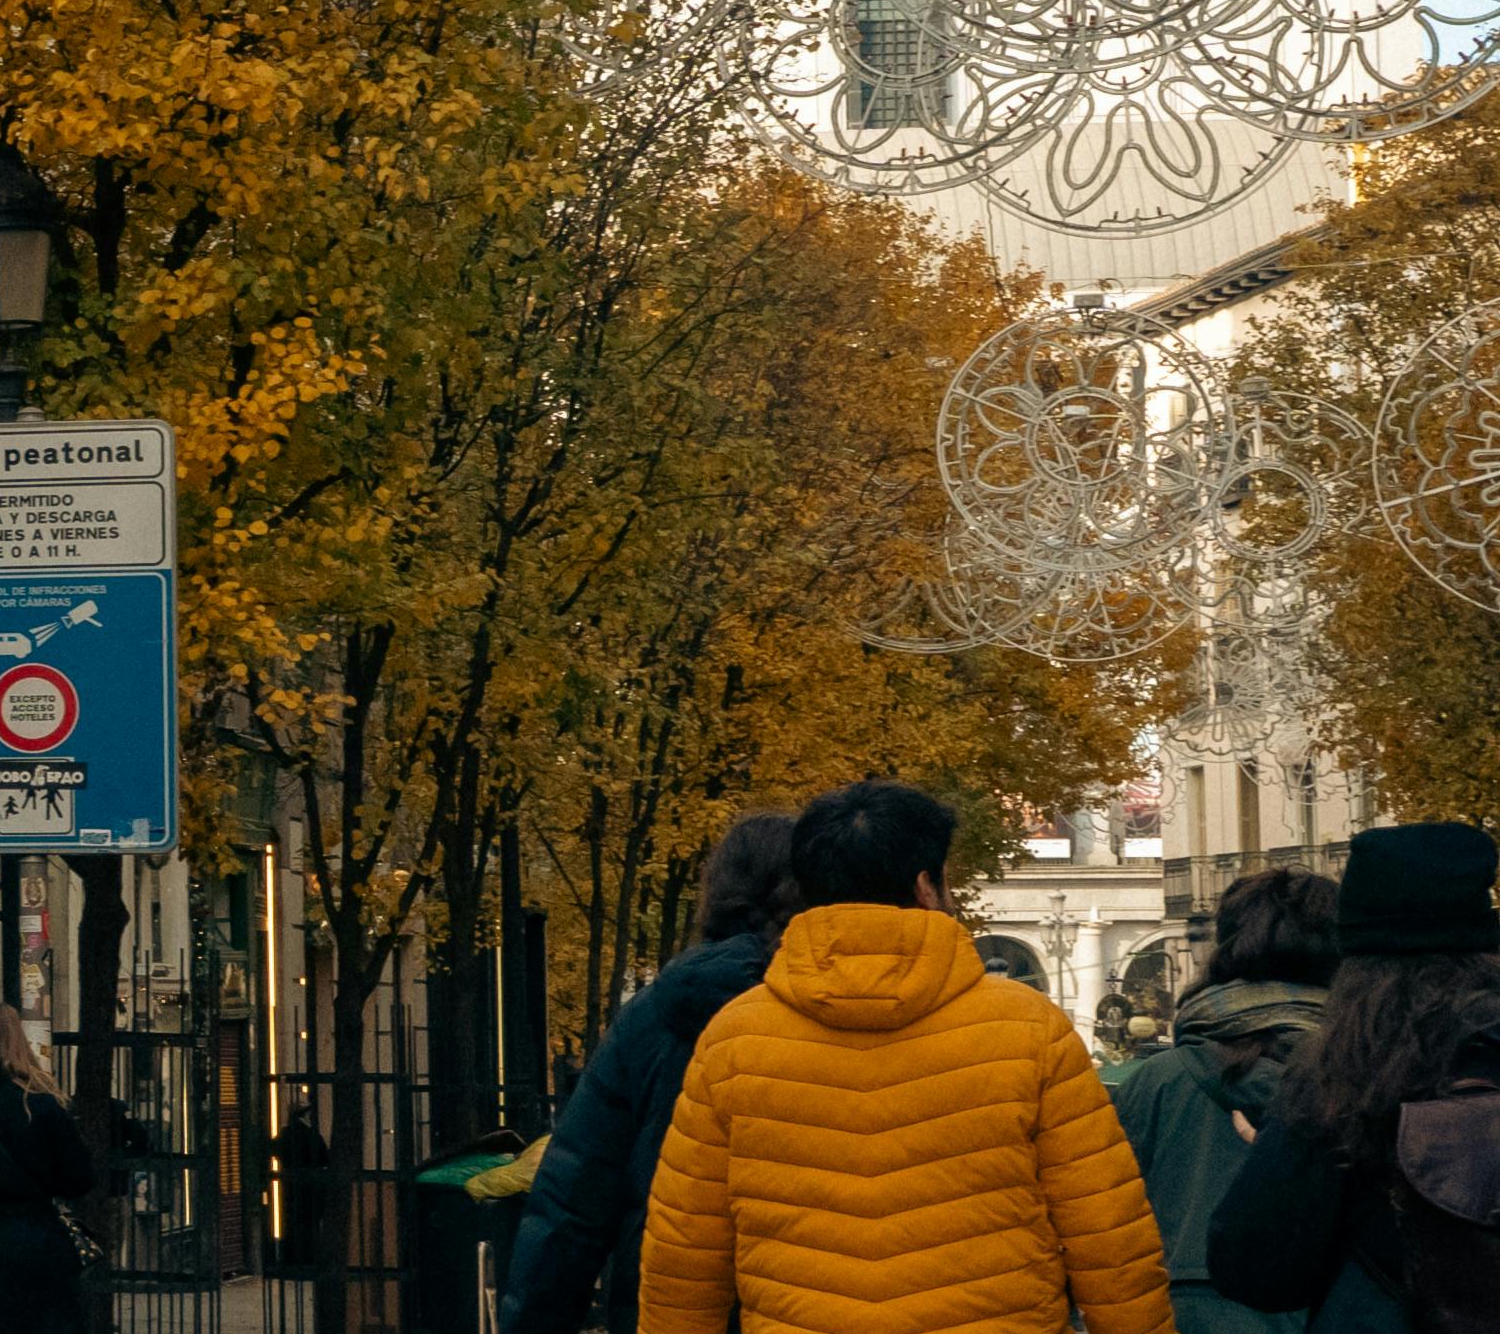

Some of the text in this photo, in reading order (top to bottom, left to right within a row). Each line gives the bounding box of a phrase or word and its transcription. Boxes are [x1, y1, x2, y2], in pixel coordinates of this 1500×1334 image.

[4, 439, 144, 471] peatonal
[10, 513, 19, 524] Y
[26, 510, 117, 524] DESCARGA
[32, 529, 43, 540] A
[50, 527, 120, 540] VIERNES
[29, 546, 40, 557] A
[47, 545, 58, 557] 11
[65, 545, 81, 557] H.
[11, 586, 26, 596] DE
[29, 585, 107, 595] INFRACCIONES
[18, 596, 71, 608] CÁMARAS
[9, 695, 56, 703] EXCEPTO
[11, 704, 55, 712] ACCESO
[10, 713, 55, 721] HOTELES
[46, 770, 85, 784] БРДО
